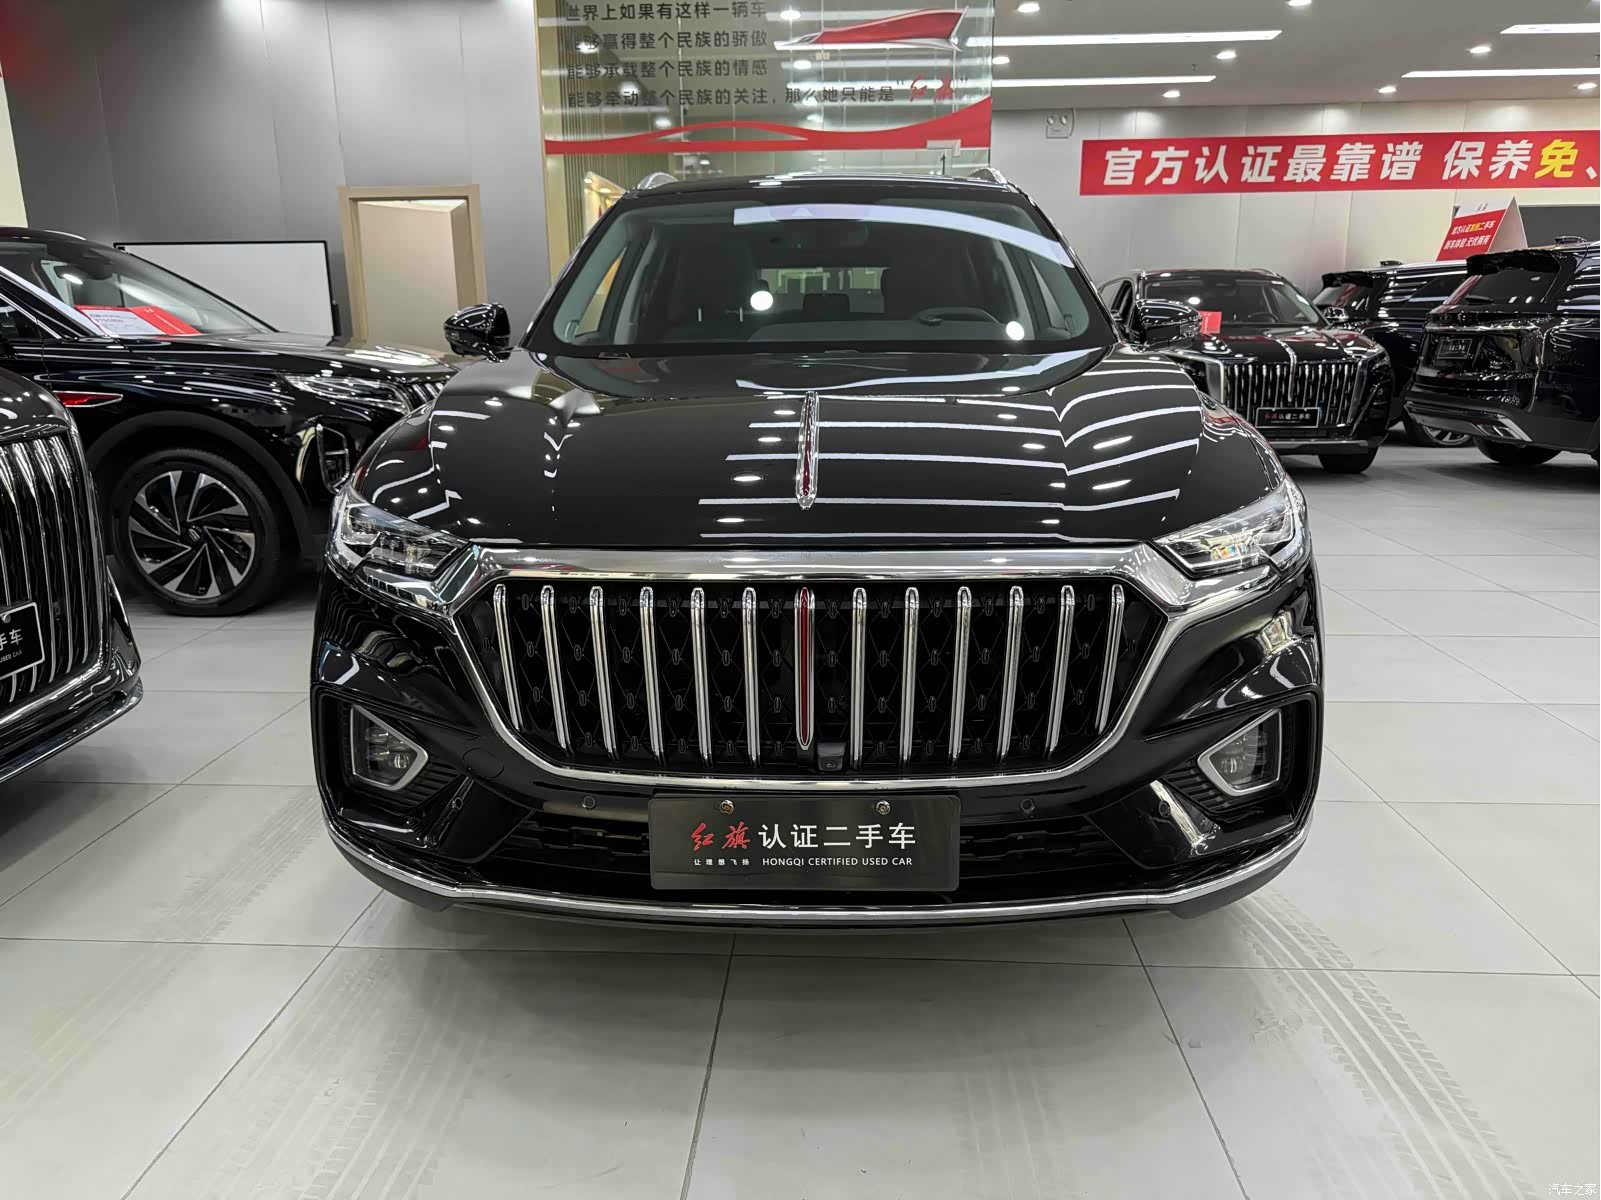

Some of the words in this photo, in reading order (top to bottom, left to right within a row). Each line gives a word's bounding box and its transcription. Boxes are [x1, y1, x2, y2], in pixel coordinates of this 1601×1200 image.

[566, 1, 767, 22] 世界上如果有这样一辆车
[568, 29, 768, 52] 够赢得整个民族的骄傲
[567, 59, 768, 79] 能够承载整个民族的情感
[1103, 142, 1424, 186] 官方认证最靠谱
[758, 822, 916, 850] 认证二手车
[762, 857, 805, 867] HONGQI
[808, 857, 858, 866] CERTIFIED
[862, 857, 888, 866] USED
[892, 857, 913, 866] CAR
